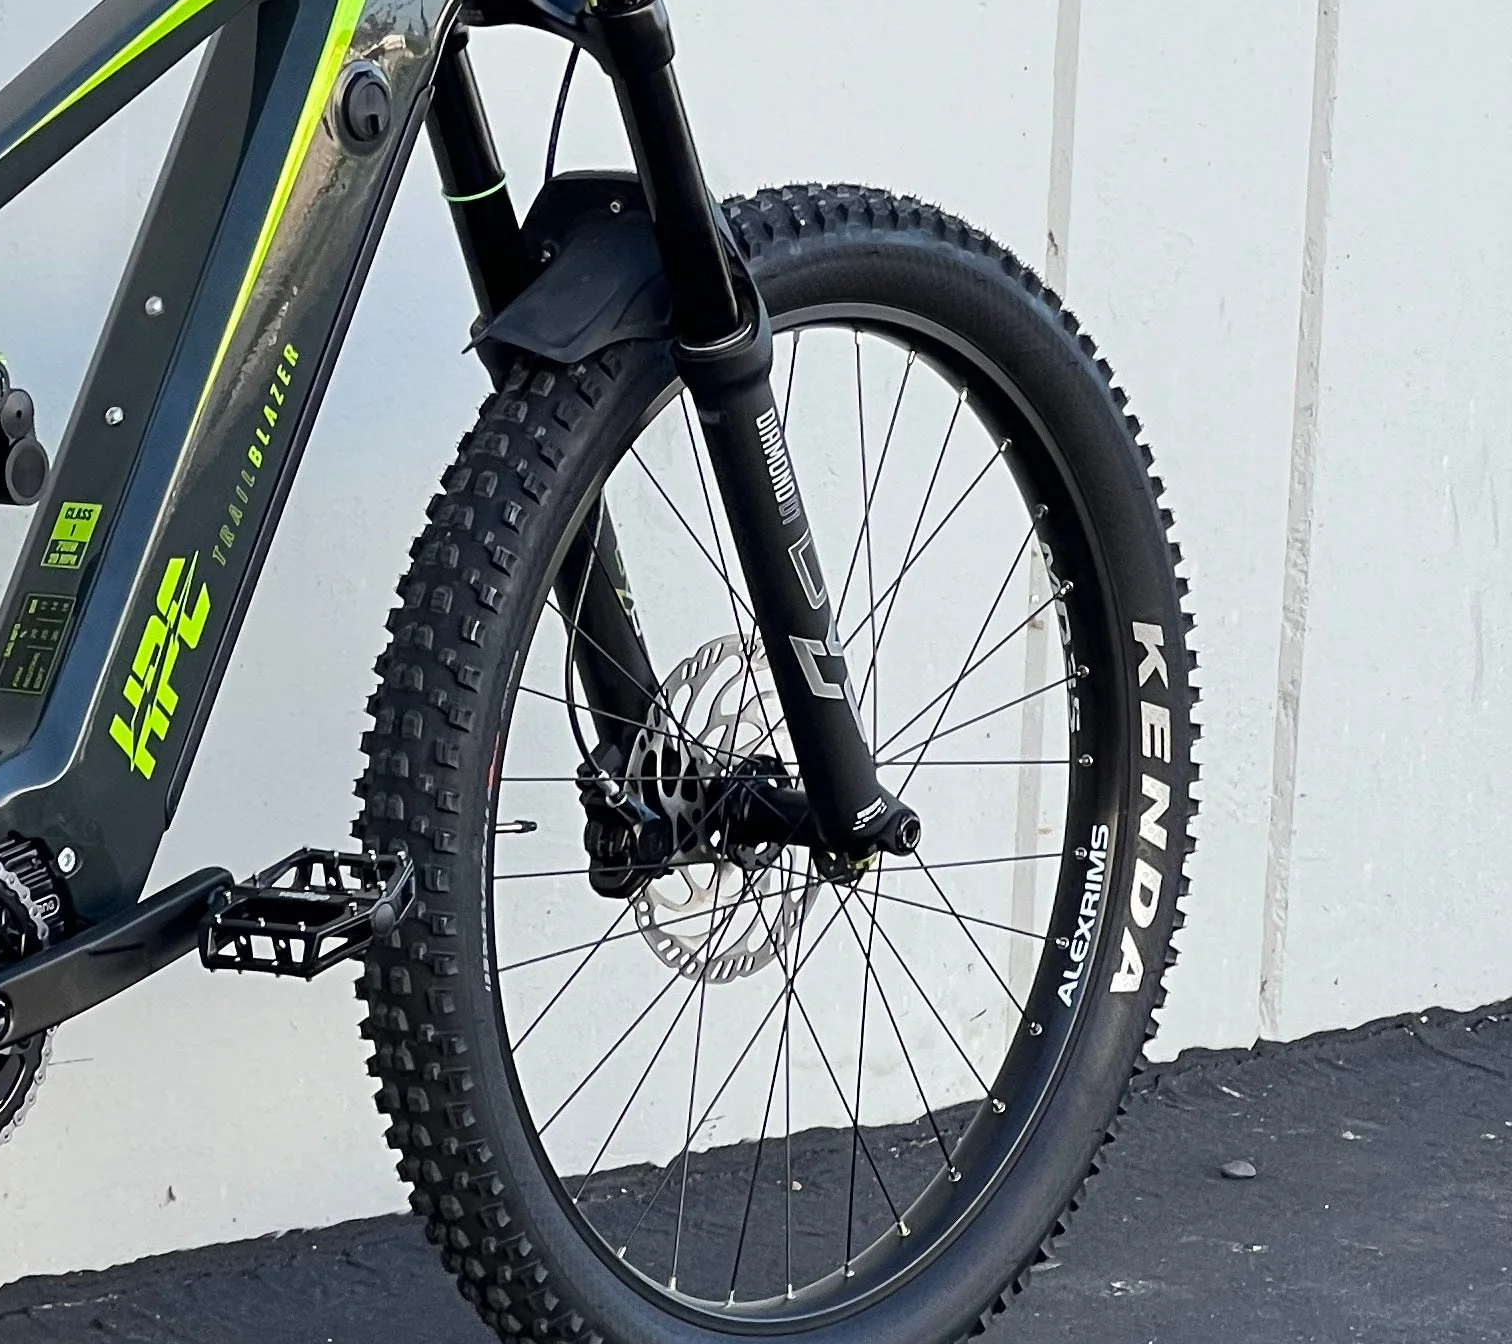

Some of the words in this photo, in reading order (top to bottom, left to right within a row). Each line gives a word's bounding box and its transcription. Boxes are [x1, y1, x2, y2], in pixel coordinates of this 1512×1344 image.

[64, 507, 93, 521] CLASS
[756, 408, 797, 503] DIAMOND
[109, 549, 211, 780] HPC
[1108, 620, 1173, 994] KENDA
[1056, 823, 1111, 1009] ALEXRIMS
